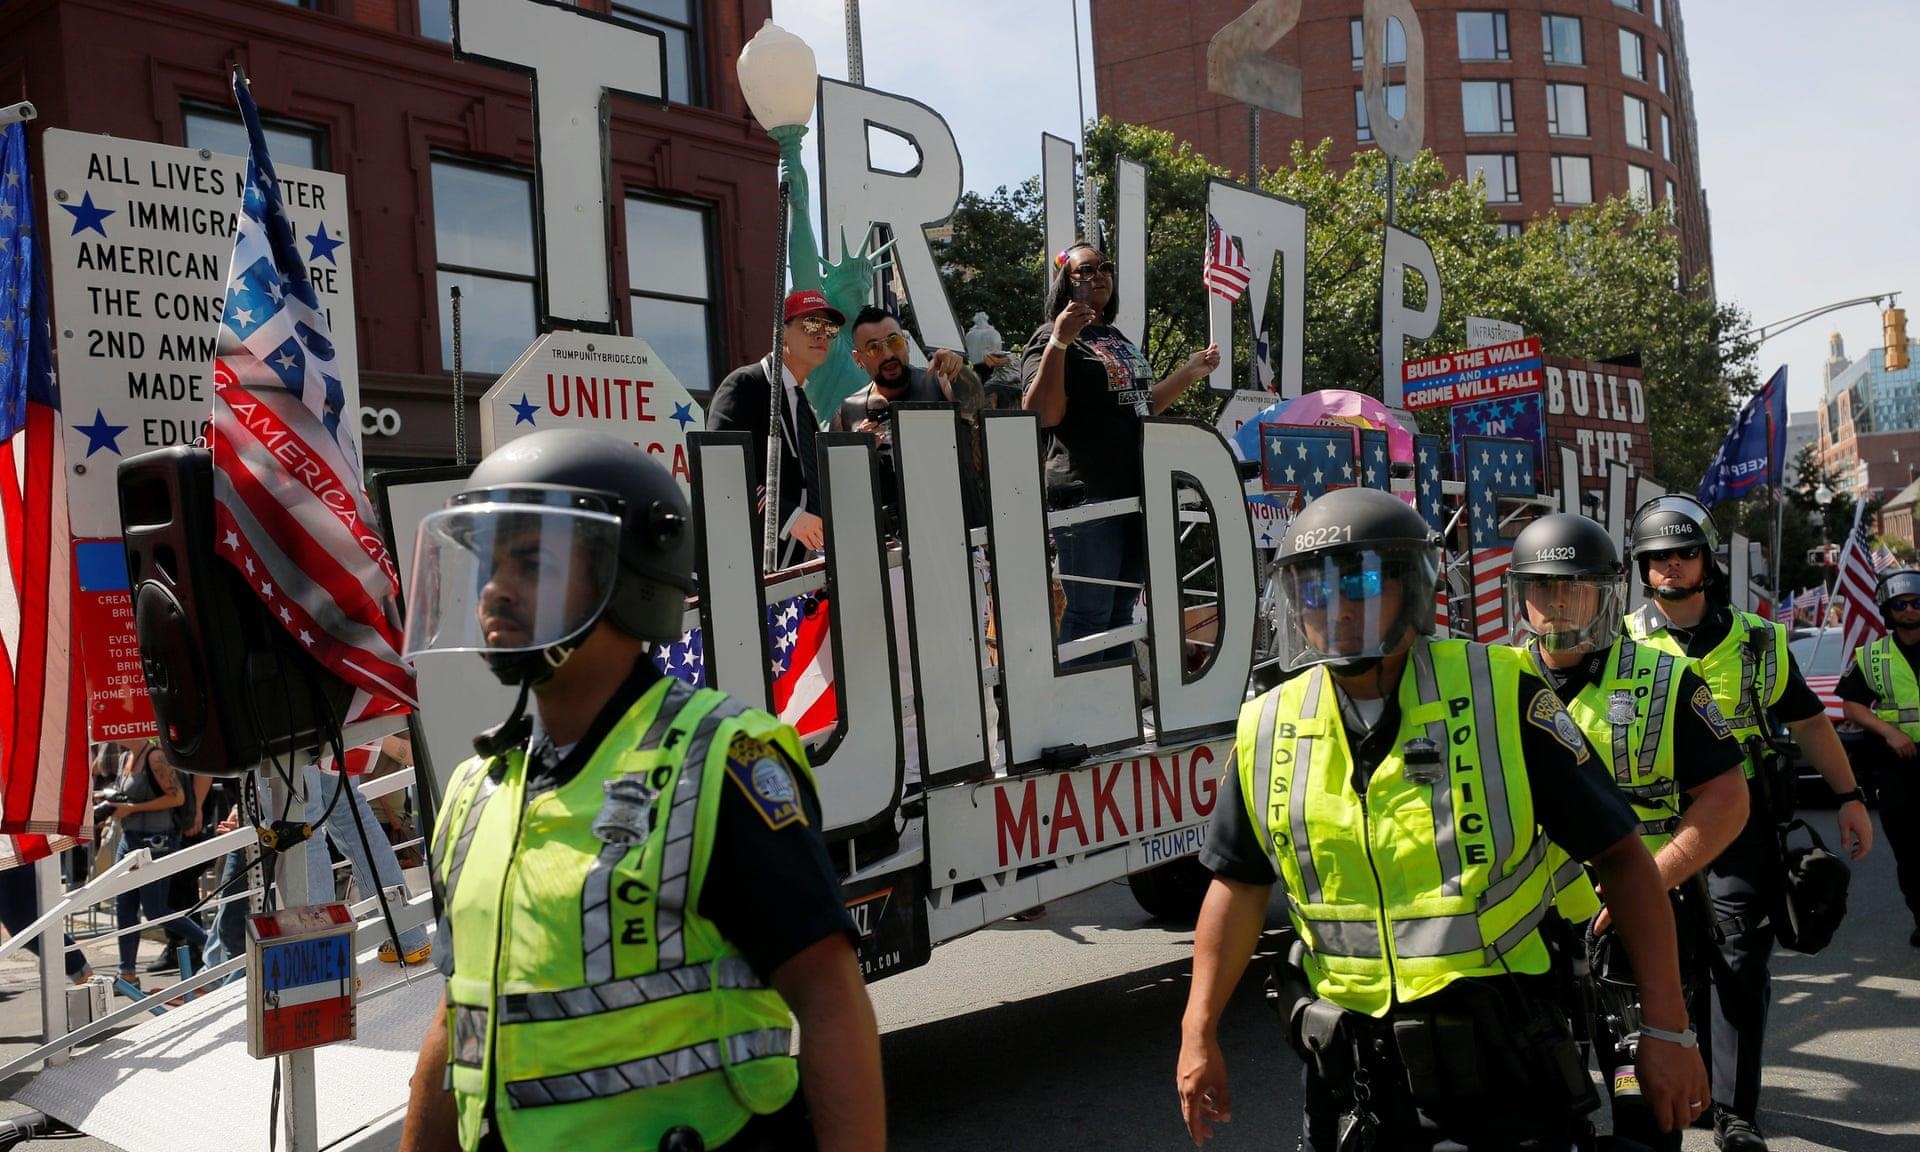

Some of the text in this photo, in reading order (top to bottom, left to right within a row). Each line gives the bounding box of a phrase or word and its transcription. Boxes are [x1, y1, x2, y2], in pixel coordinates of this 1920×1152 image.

[87, 152, 140, 186] ALL
[151, 160, 224, 196] LIVES
[453, 0, 1443, 410] TRUMP
[77, 241, 219, 282] AMERICAN
[87, 286, 142, 318] THE
[87, 329, 146, 360] 2ND
[551, 349, 648, 365] TRUMPUNITYBRIDGE.COM
[1407, 342, 1534, 380] BUILD THE WALL
[128, 371, 204, 402] MADE
[1407, 374, 1539, 408] CRIME WILL FALL
[1458, 370, 1481, 383] AND
[546, 373, 656, 422] UNITE
[1546, 366, 1646, 424] BUILD
[1486, 419, 1506, 436] IN
[230, 402, 359, 530] AMERICA
[1576, 429, 1636, 478] THE
[1294, 525, 1352, 552] 86221
[1659, 523, 1693, 536] 117846
[1535, 547, 1576, 562] 144329
[109, 649, 123, 658] TO
[93, 691, 126, 701] HOME
[1446, 696, 1489, 865] POLICE
[994, 745, 1217, 867] MAKING
[284, 939, 333, 987] DONATE
